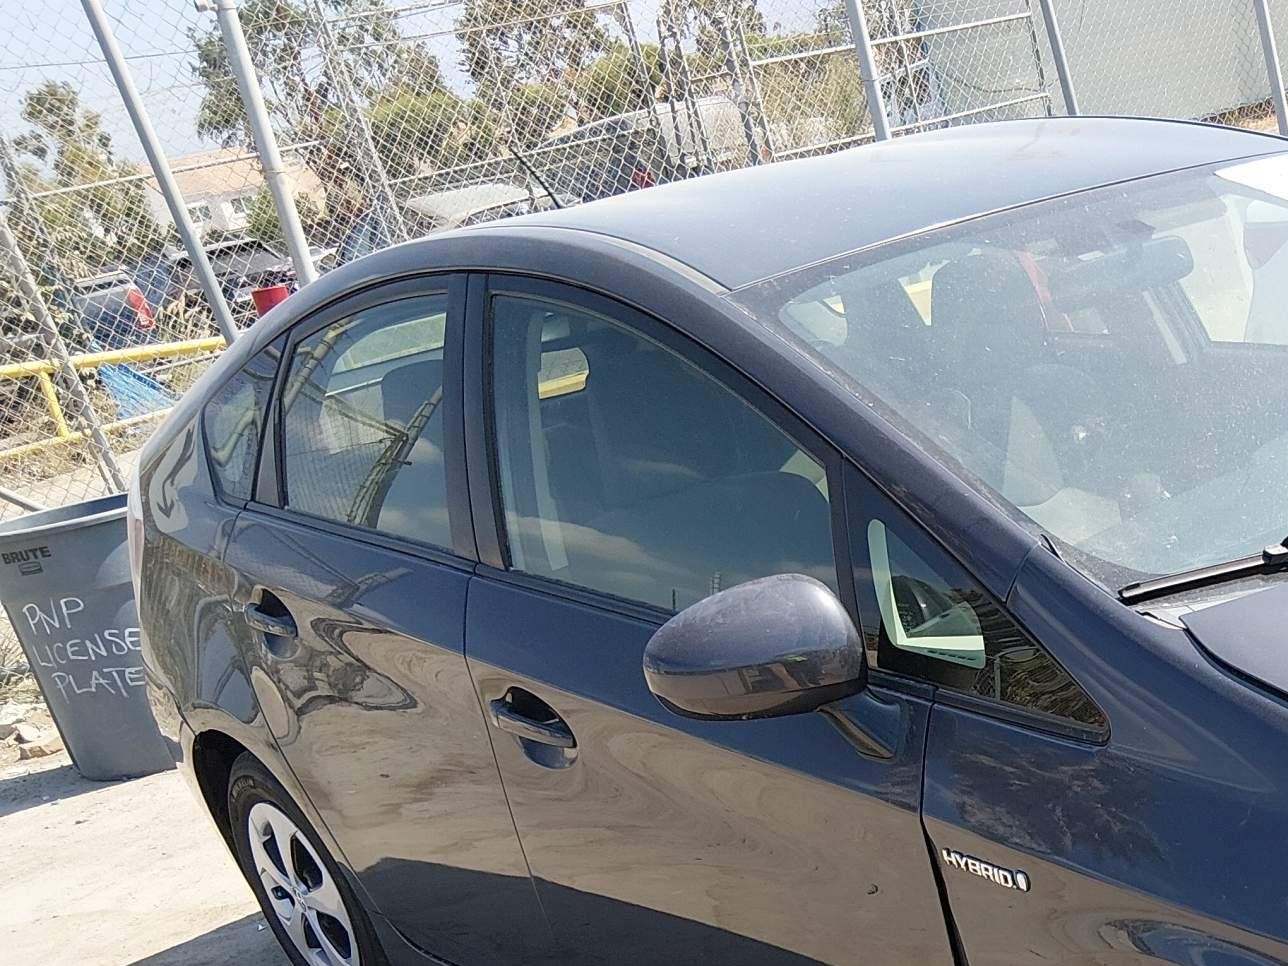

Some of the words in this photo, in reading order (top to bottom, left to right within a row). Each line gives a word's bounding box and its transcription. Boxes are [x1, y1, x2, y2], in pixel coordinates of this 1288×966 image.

[1, 546, 52, 565] BRUTE
[22, 597, 84, 636] PNP
[32, 627, 141, 670] LICENSE
[51, 666, 146, 704] PLATE
